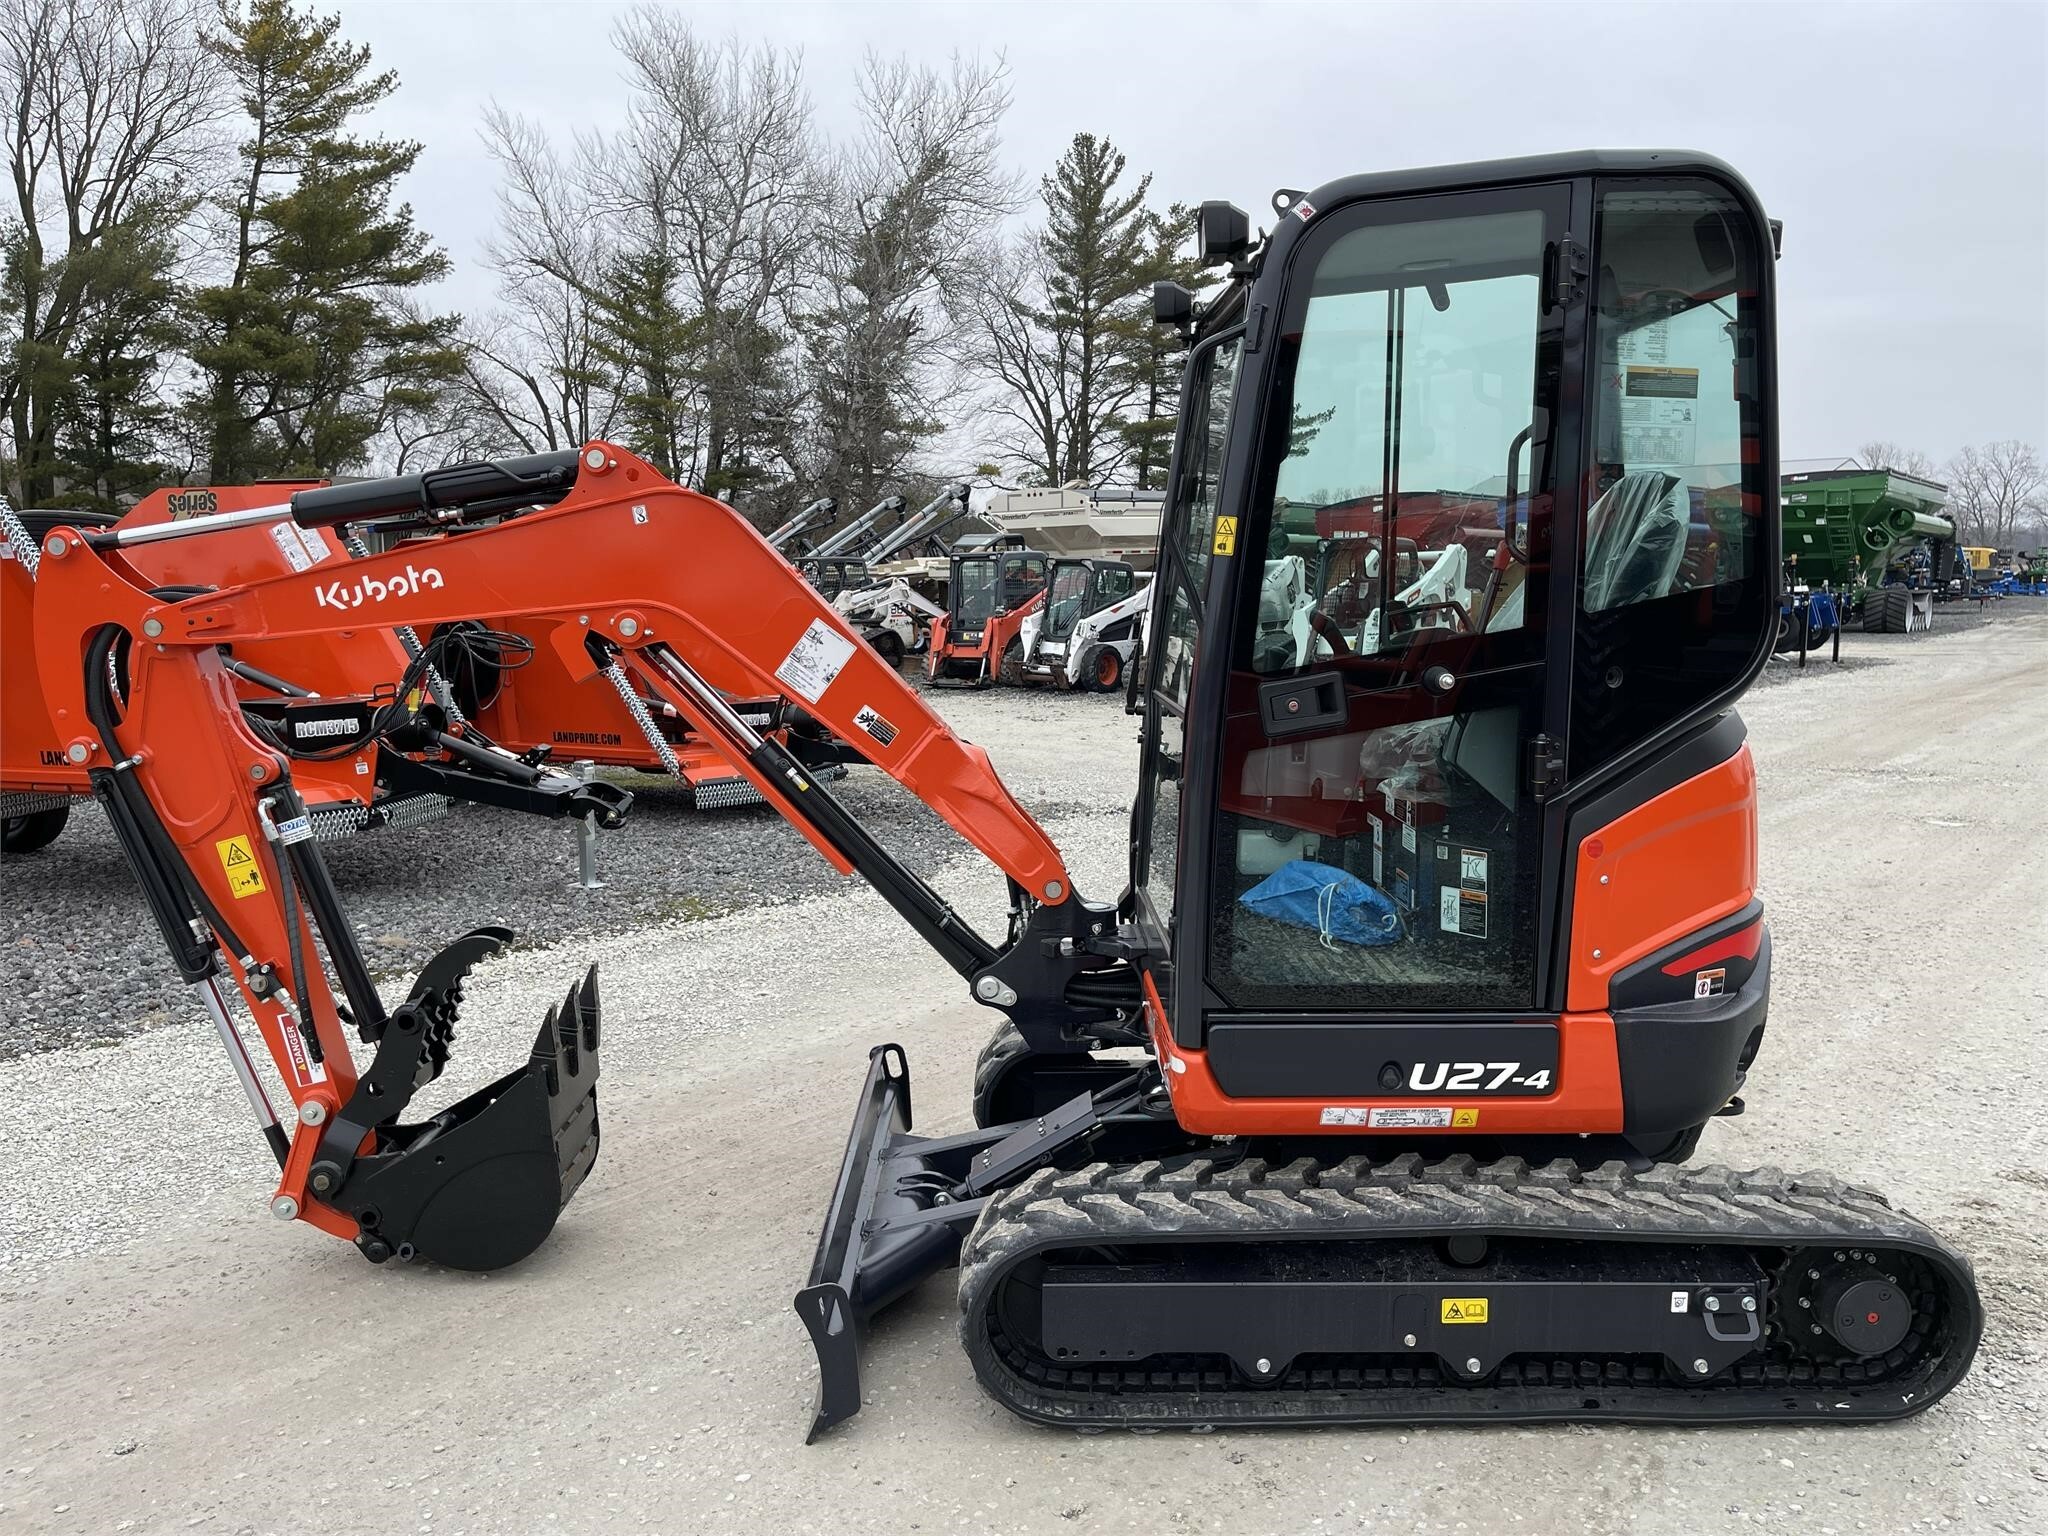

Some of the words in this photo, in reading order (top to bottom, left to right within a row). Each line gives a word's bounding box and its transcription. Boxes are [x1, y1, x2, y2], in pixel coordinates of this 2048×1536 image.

[168, 492, 218, 515] Series
[314, 564, 445, 610] Kubota
[295, 717, 360, 738] RCM3715
[552, 731, 622, 746] LANDPRIDE.COM
[279, 818, 307, 833] NOTIC
[286, 1025, 304, 1064] DANGER
[1409, 1062, 1551, 1091] U27-4
